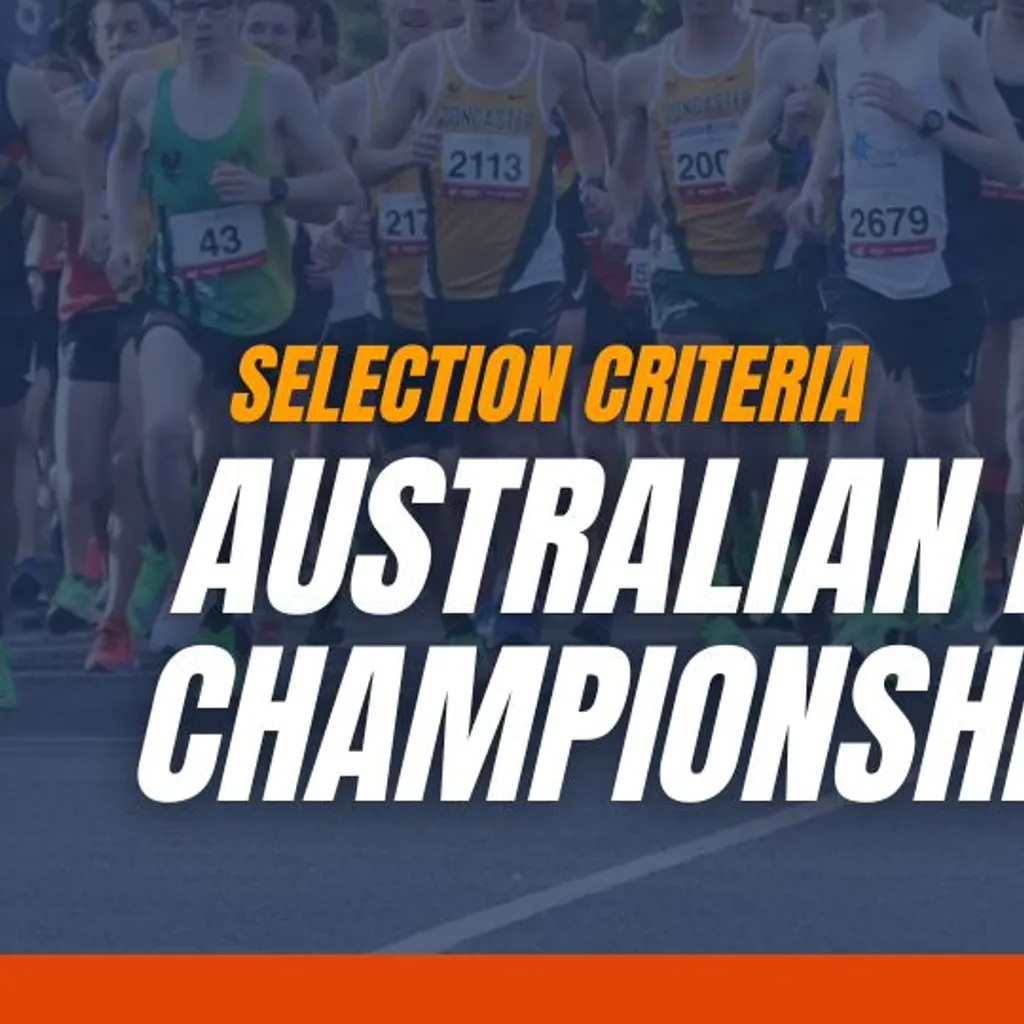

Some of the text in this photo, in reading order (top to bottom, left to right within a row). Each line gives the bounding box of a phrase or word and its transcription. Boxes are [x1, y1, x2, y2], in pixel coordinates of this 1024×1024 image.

[449, 150, 522, 182] 2113
[850, 205, 930, 238] 2679
[200, 224, 242, 256] 43
